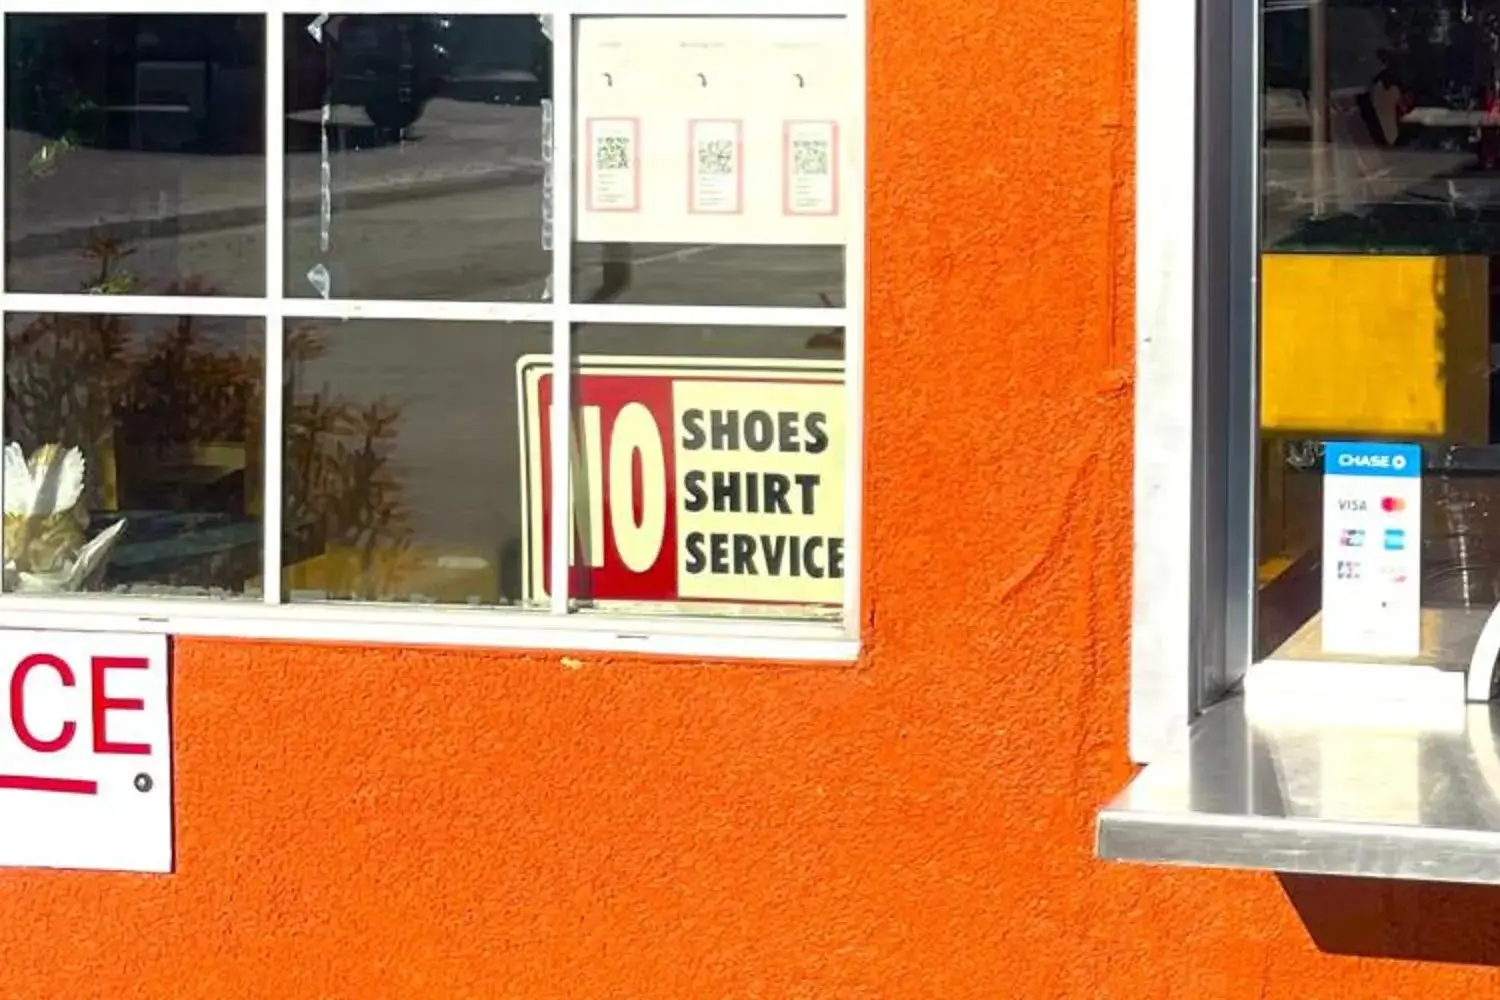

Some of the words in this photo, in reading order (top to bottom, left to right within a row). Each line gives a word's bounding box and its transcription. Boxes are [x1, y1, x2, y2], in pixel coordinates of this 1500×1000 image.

[681, 408, 829, 454] SHOES
[1338, 453, 1390, 468] CHASE
[548, 402, 667, 573] NO
[684, 470, 821, 515] SHIRT
[1338, 499, 1367, 511] VISA
[685, 531, 845, 579] SERVICE
[9, 652, 152, 755] CE
